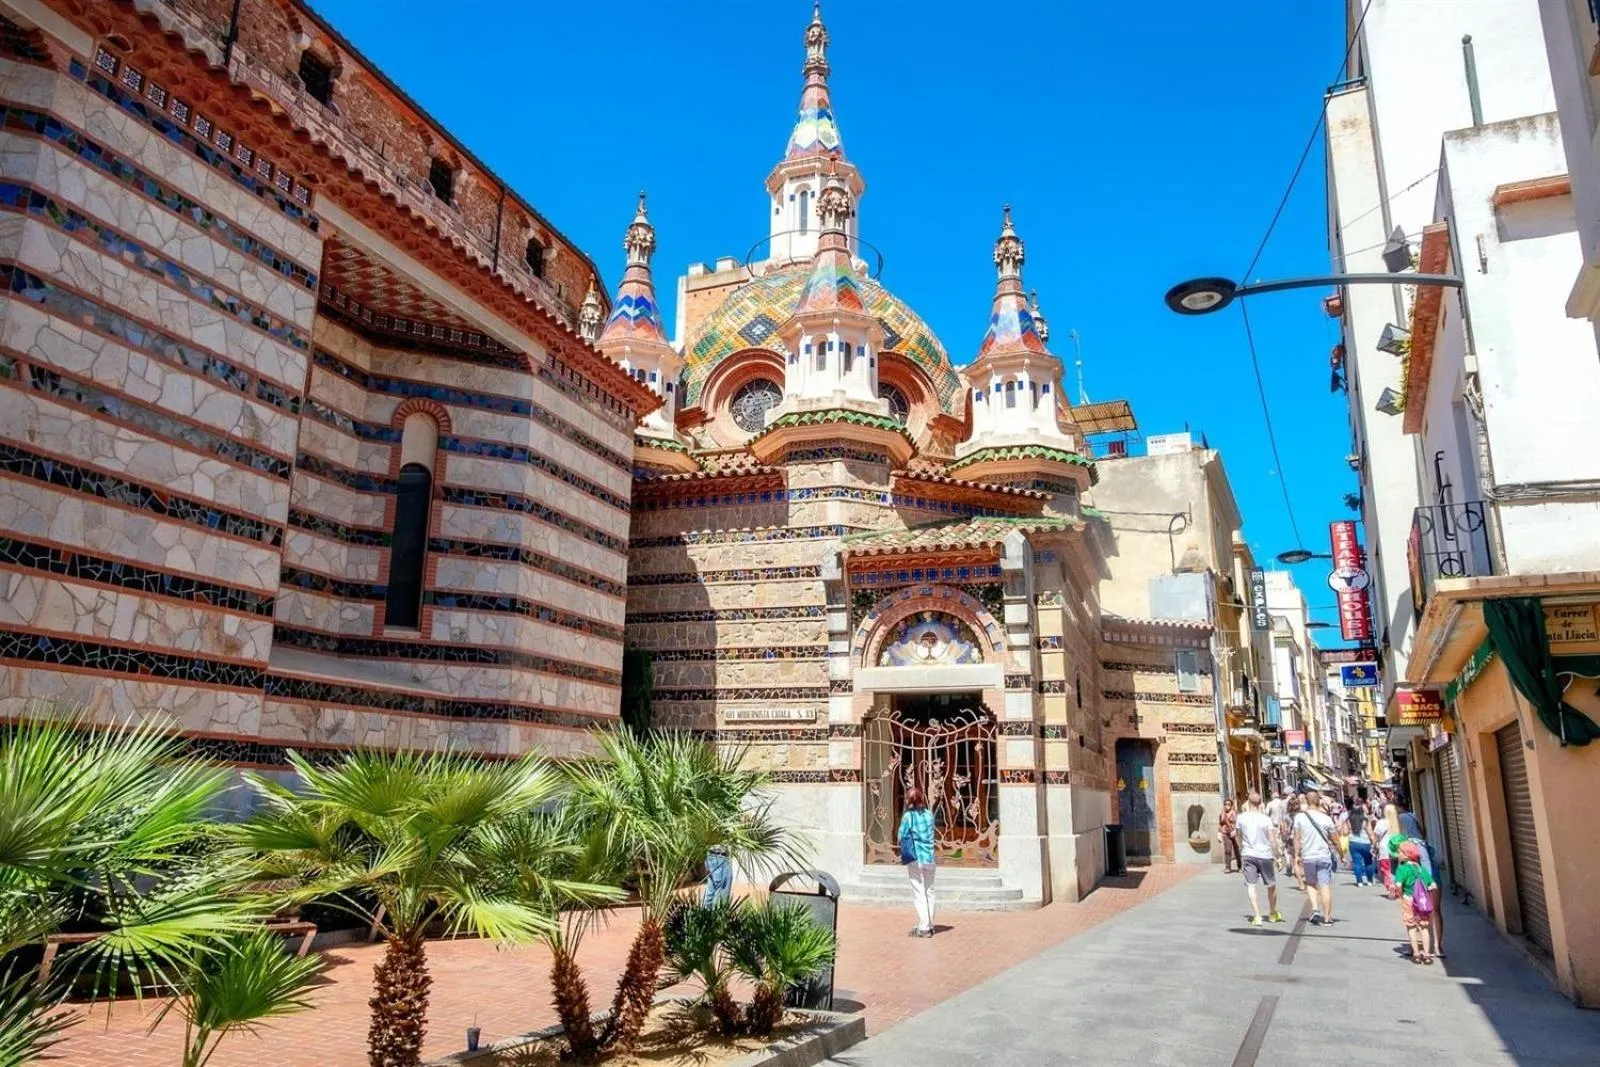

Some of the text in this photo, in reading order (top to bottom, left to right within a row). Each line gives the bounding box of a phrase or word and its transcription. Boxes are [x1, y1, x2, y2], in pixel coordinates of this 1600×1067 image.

[1335, 522, 1359, 567] STEAK
[1342, 592, 1362, 638] HOUSE
[1553, 609, 1589, 619] Carrer
[1562, 619, 1573, 628] de
[1399, 703, 1440, 711] TABACS
